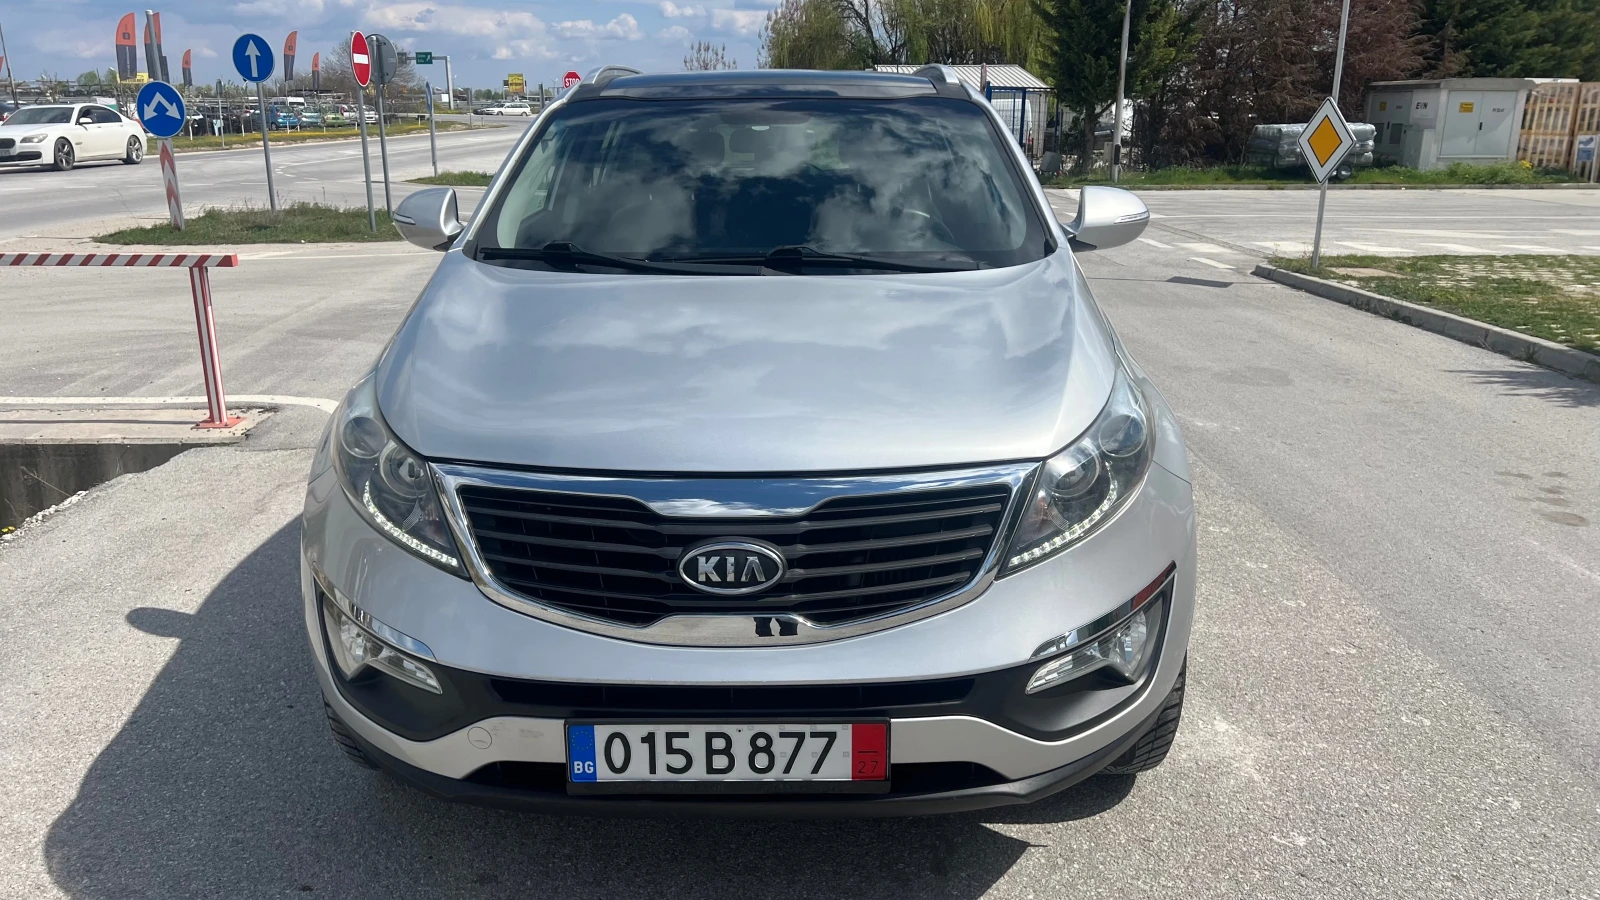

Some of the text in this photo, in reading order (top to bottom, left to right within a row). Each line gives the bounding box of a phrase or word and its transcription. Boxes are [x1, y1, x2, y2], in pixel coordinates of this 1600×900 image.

[696, 556, 766, 582] KIA
[573, 761, 594, 774] BG
[857, 760, 879, 774] 27
